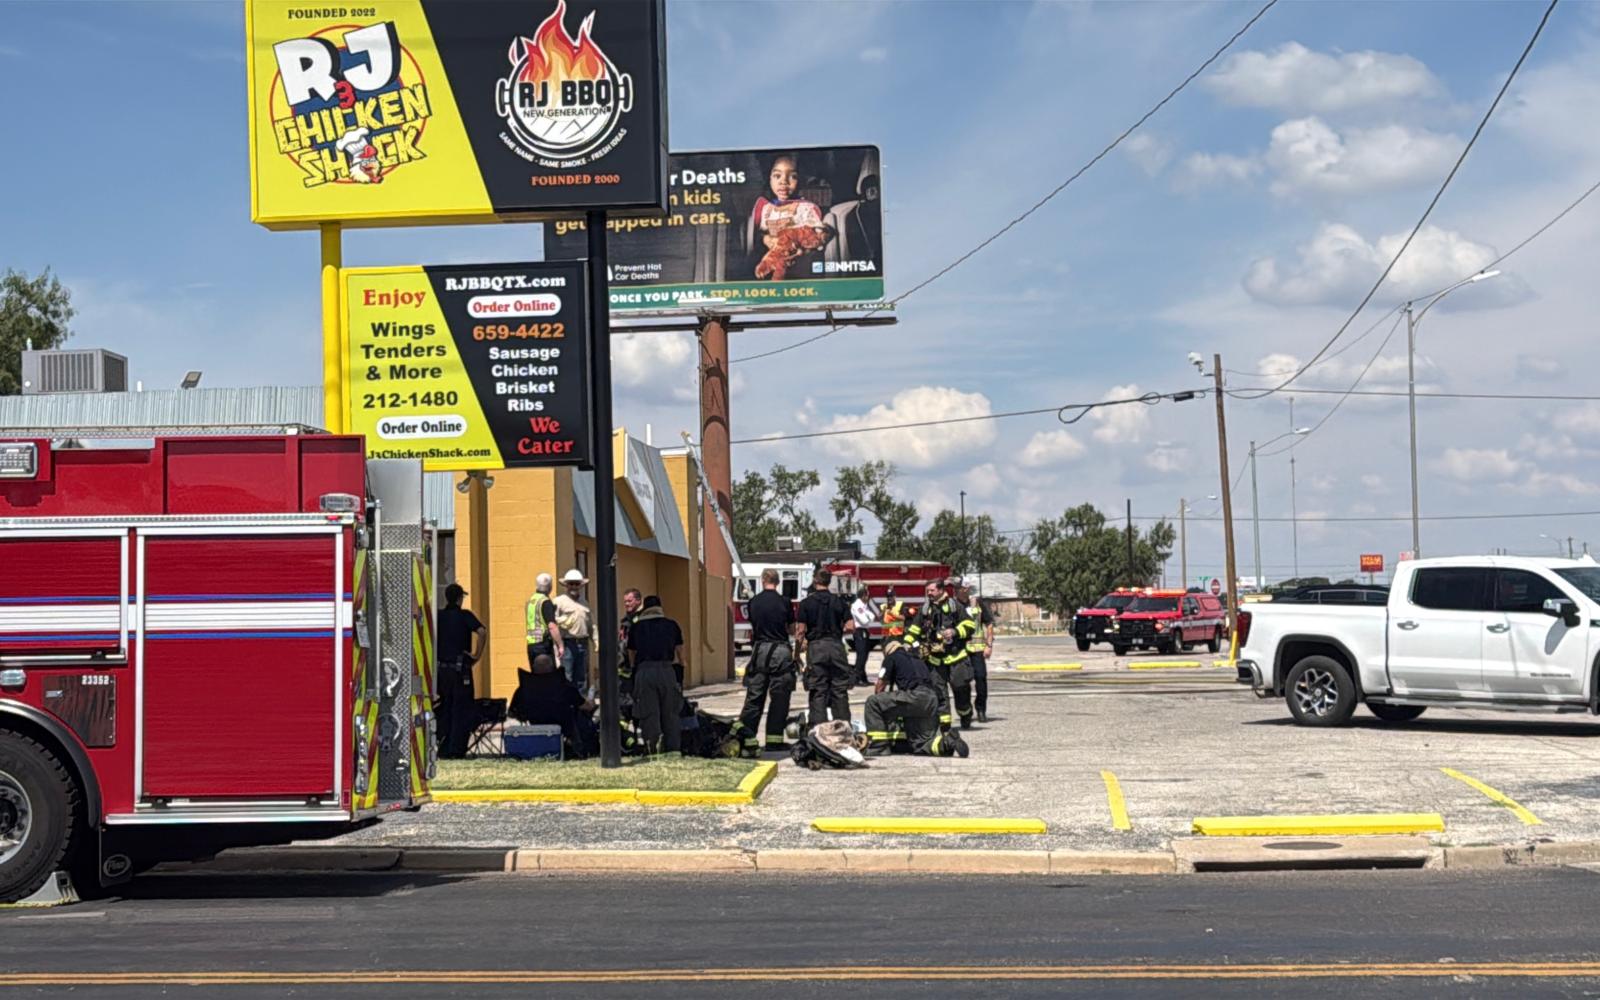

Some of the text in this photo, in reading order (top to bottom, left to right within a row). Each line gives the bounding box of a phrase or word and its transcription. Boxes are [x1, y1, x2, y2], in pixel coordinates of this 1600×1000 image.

[288, 8, 376, 19] FOUNDED 2022
[519, 79, 612, 108] RJ BBQ
[274, 83, 433, 154] CHICKEN
[523, 107, 607, 118] NEW GENERATION
[499, 128, 627, 168] SAME NAME SAME SMOKE FRESH IDEAS
[531, 174, 620, 186] FOUNDED 2000
[682, 168, 746, 185] Deaths
[684, 189, 721, 205] kids
[690, 212, 731, 226] cars.
[836, 260, 876, 272] NHTSA
[445, 276, 566, 291] RJBBQTX.com
[631, 272, 659, 280] Deaths
[363, 289, 426, 308] Enjoy
[609, 294, 641, 303] ONCE
[644, 292, 669, 302] YOU
[473, 299, 556, 313] Order Online
[371, 322, 436, 340] Wings
[472, 323, 565, 341] 659-4422
[361, 343, 447, 359] Tenders
[489, 347, 561, 361] Sausage
[366, 364, 443, 380] & More
[491, 364, 558, 377] Chicken
[495, 381, 555, 395] Brisket
[363, 391, 458, 408] 212-1480
[507, 399, 544, 412] Ribs
[381, 420, 462, 434] Order Online
[529, 417, 561, 434] We
[518, 438, 573, 454] Cater
